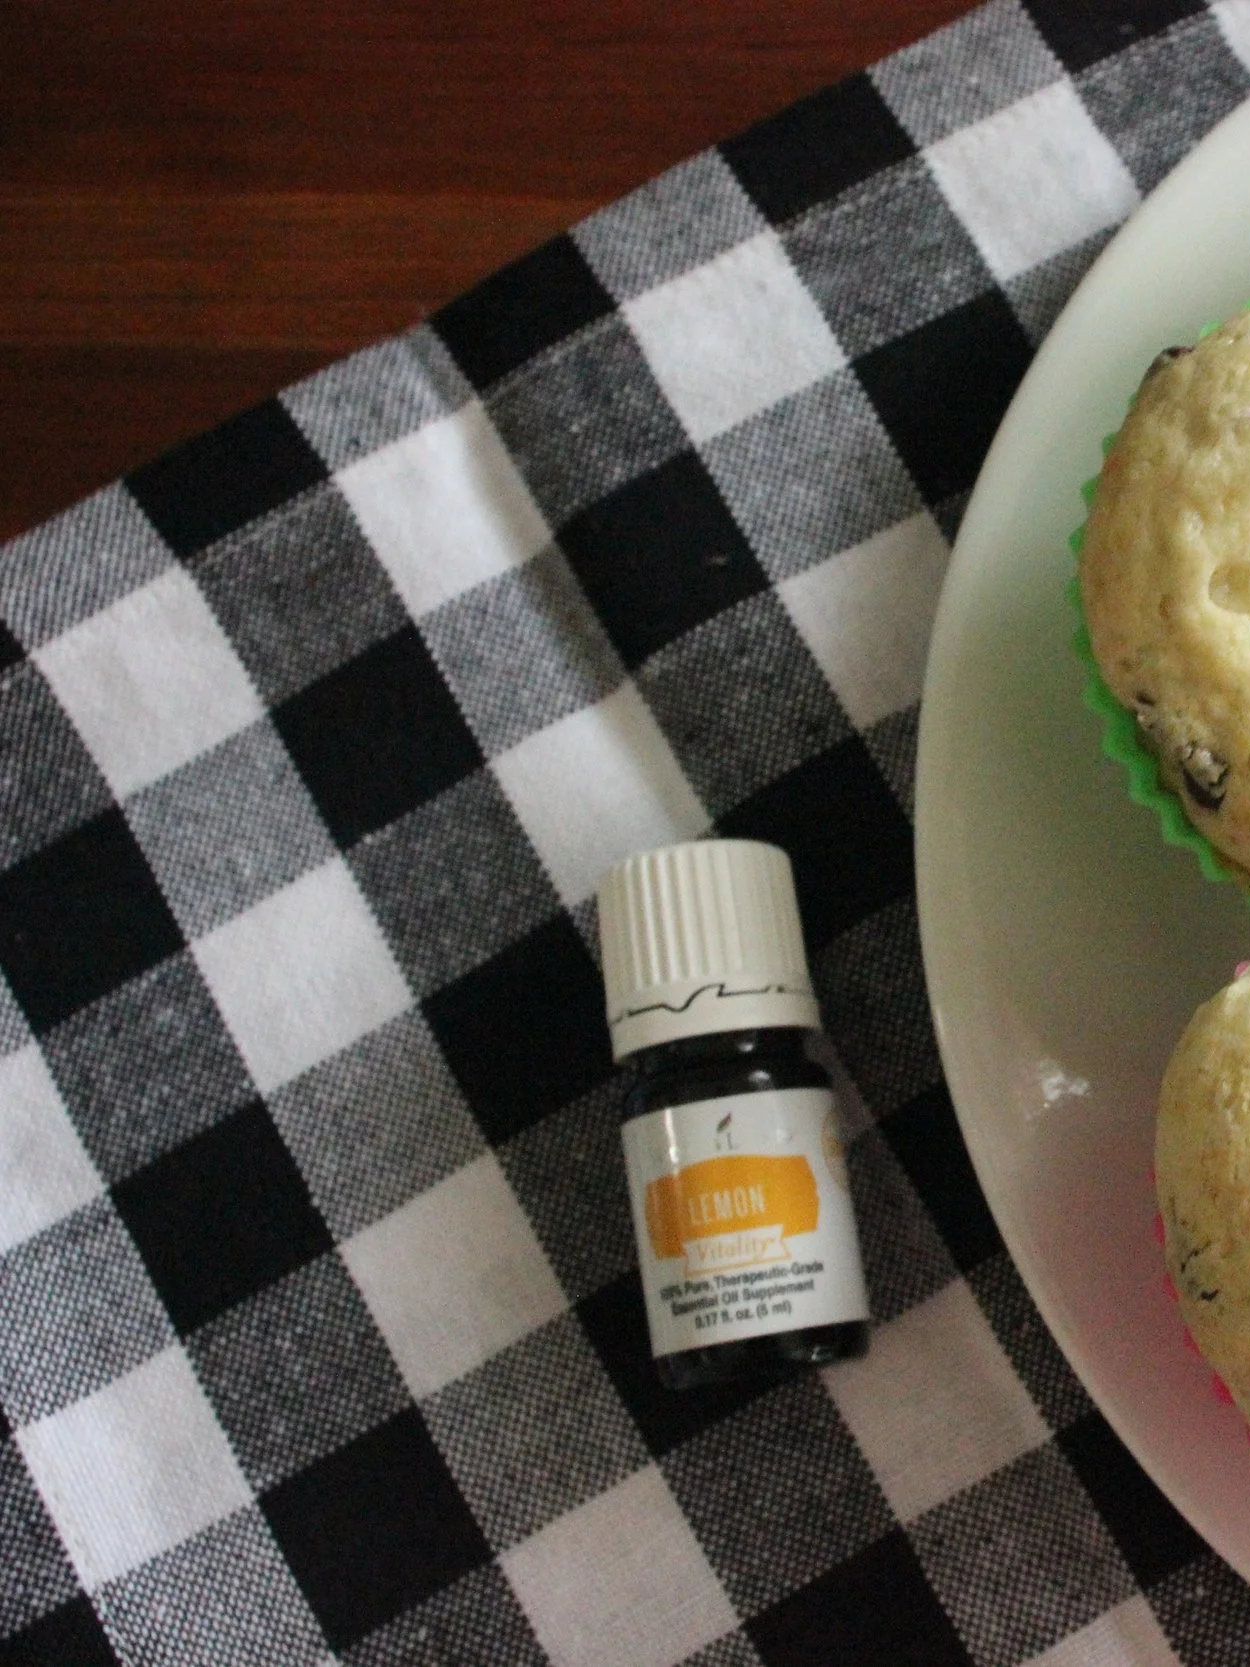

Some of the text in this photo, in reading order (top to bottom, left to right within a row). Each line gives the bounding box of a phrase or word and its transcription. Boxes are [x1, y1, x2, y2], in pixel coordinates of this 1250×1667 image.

[688, 1184, 766, 1226] LEMON
[714, 1260, 824, 1289] Therapeutic-Grade
[722, 1290, 739, 1305] Oil
[743, 1279, 815, 1302] Supplement
[771, 1299, 793, 1316] ml)
